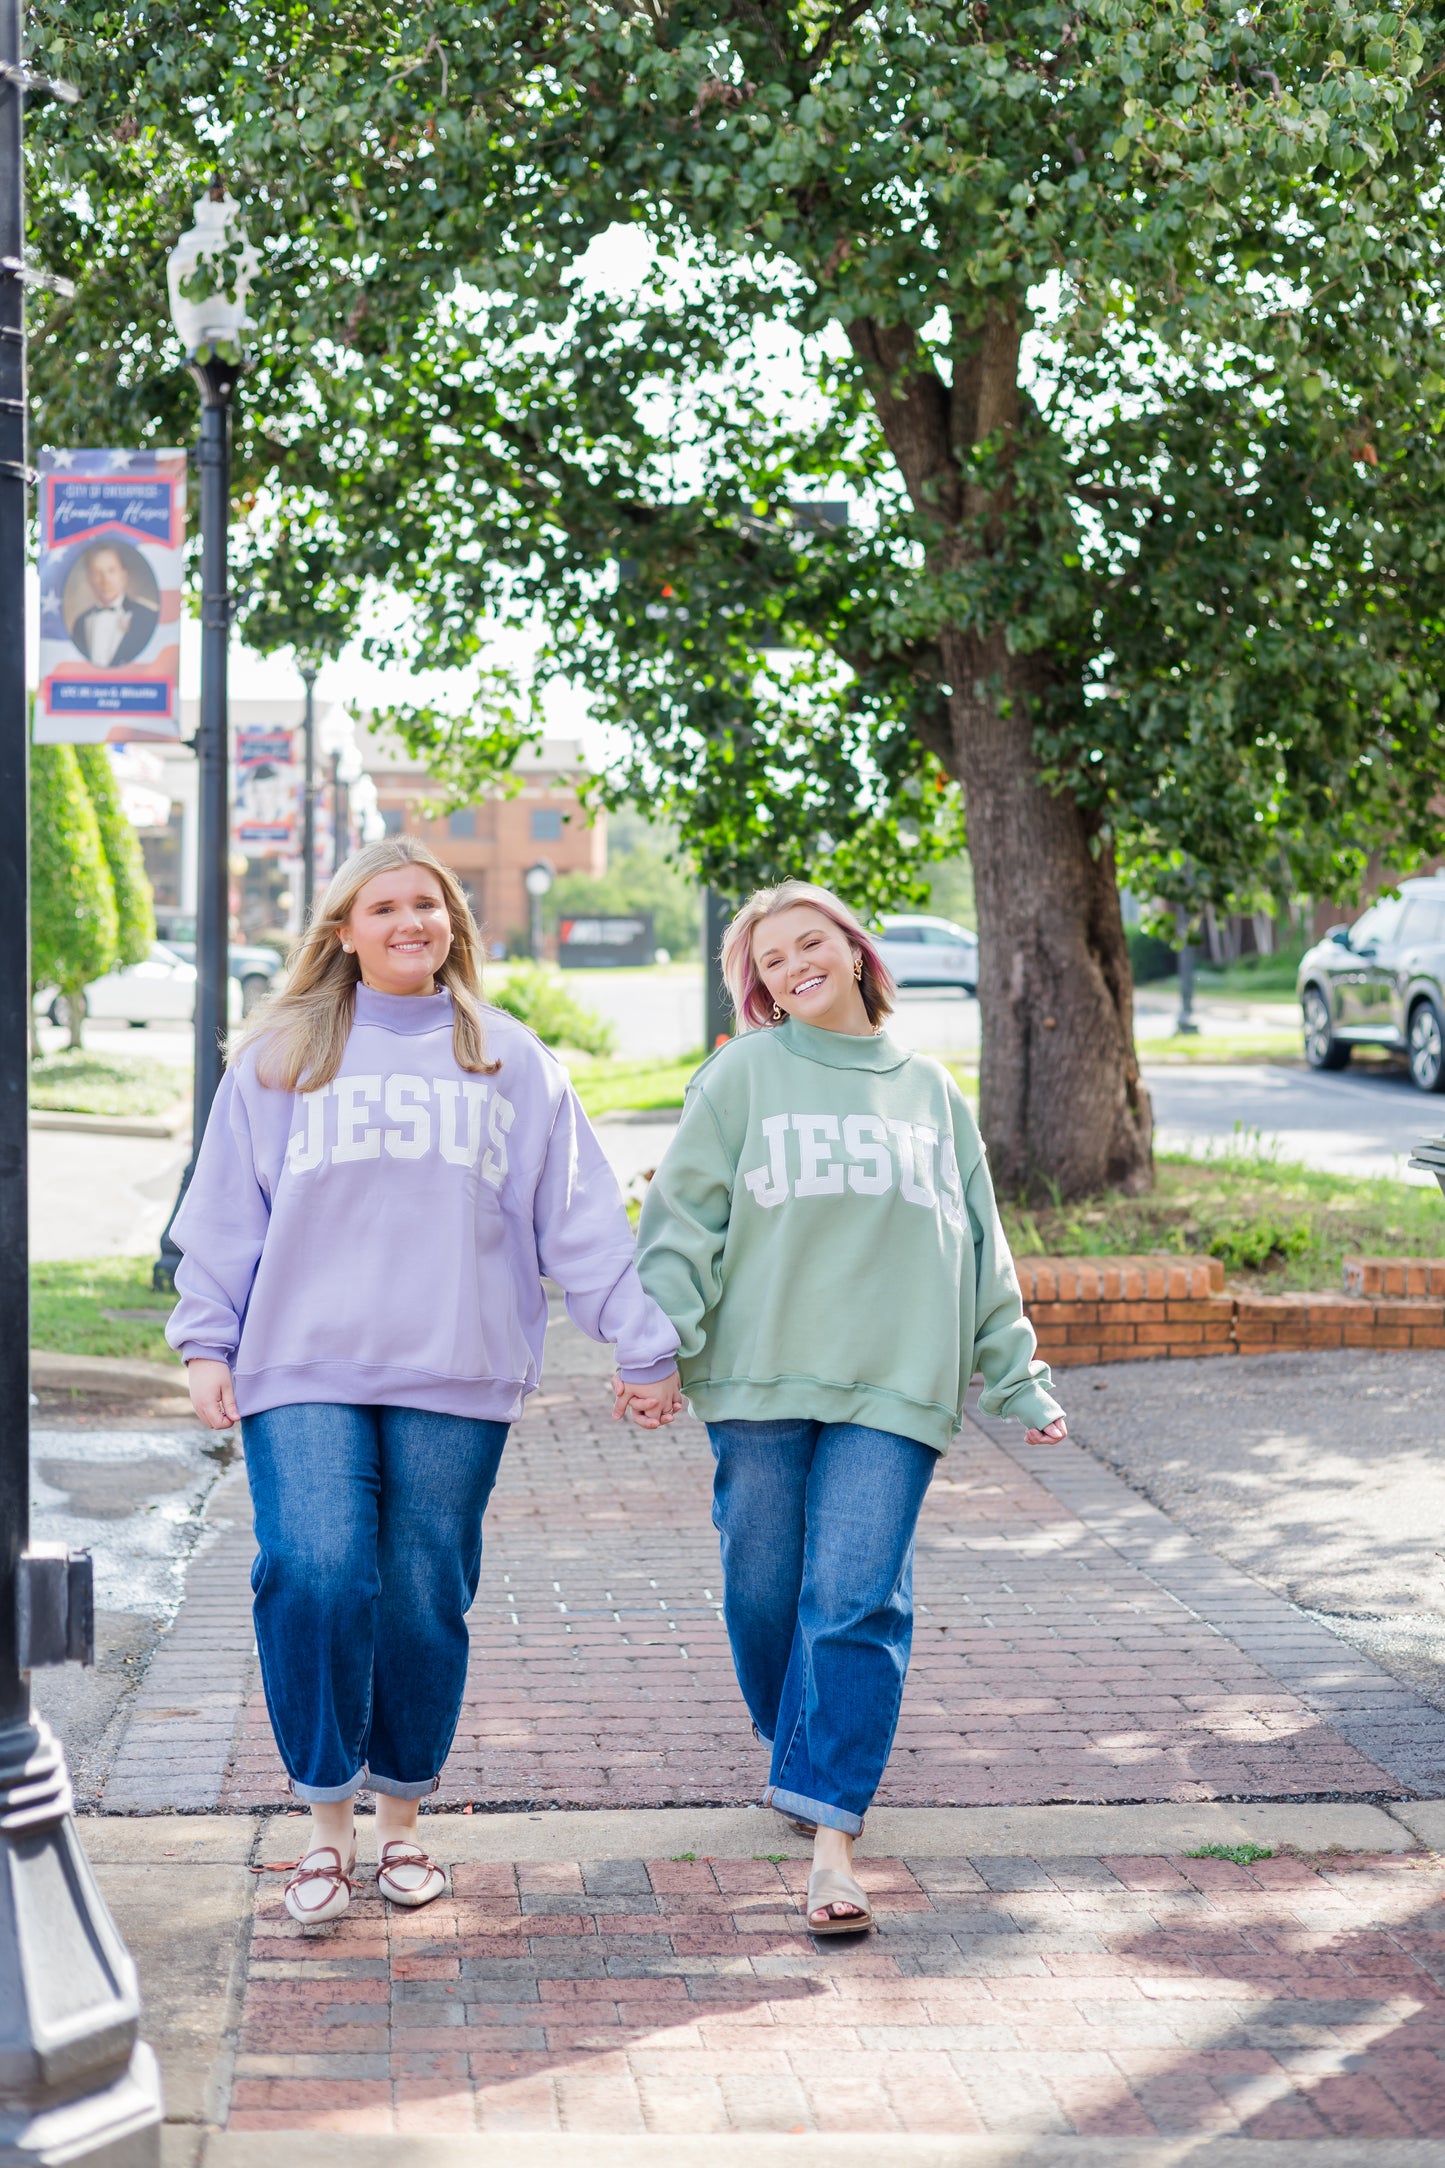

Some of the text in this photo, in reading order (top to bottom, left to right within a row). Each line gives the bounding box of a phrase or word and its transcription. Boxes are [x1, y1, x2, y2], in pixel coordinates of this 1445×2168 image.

[65, 484, 87, 499] CITY
[88, 484, 101, 499] OF
[288, 1074, 516, 1188] JESUS
[744, 1113, 967, 1232] JESUS
